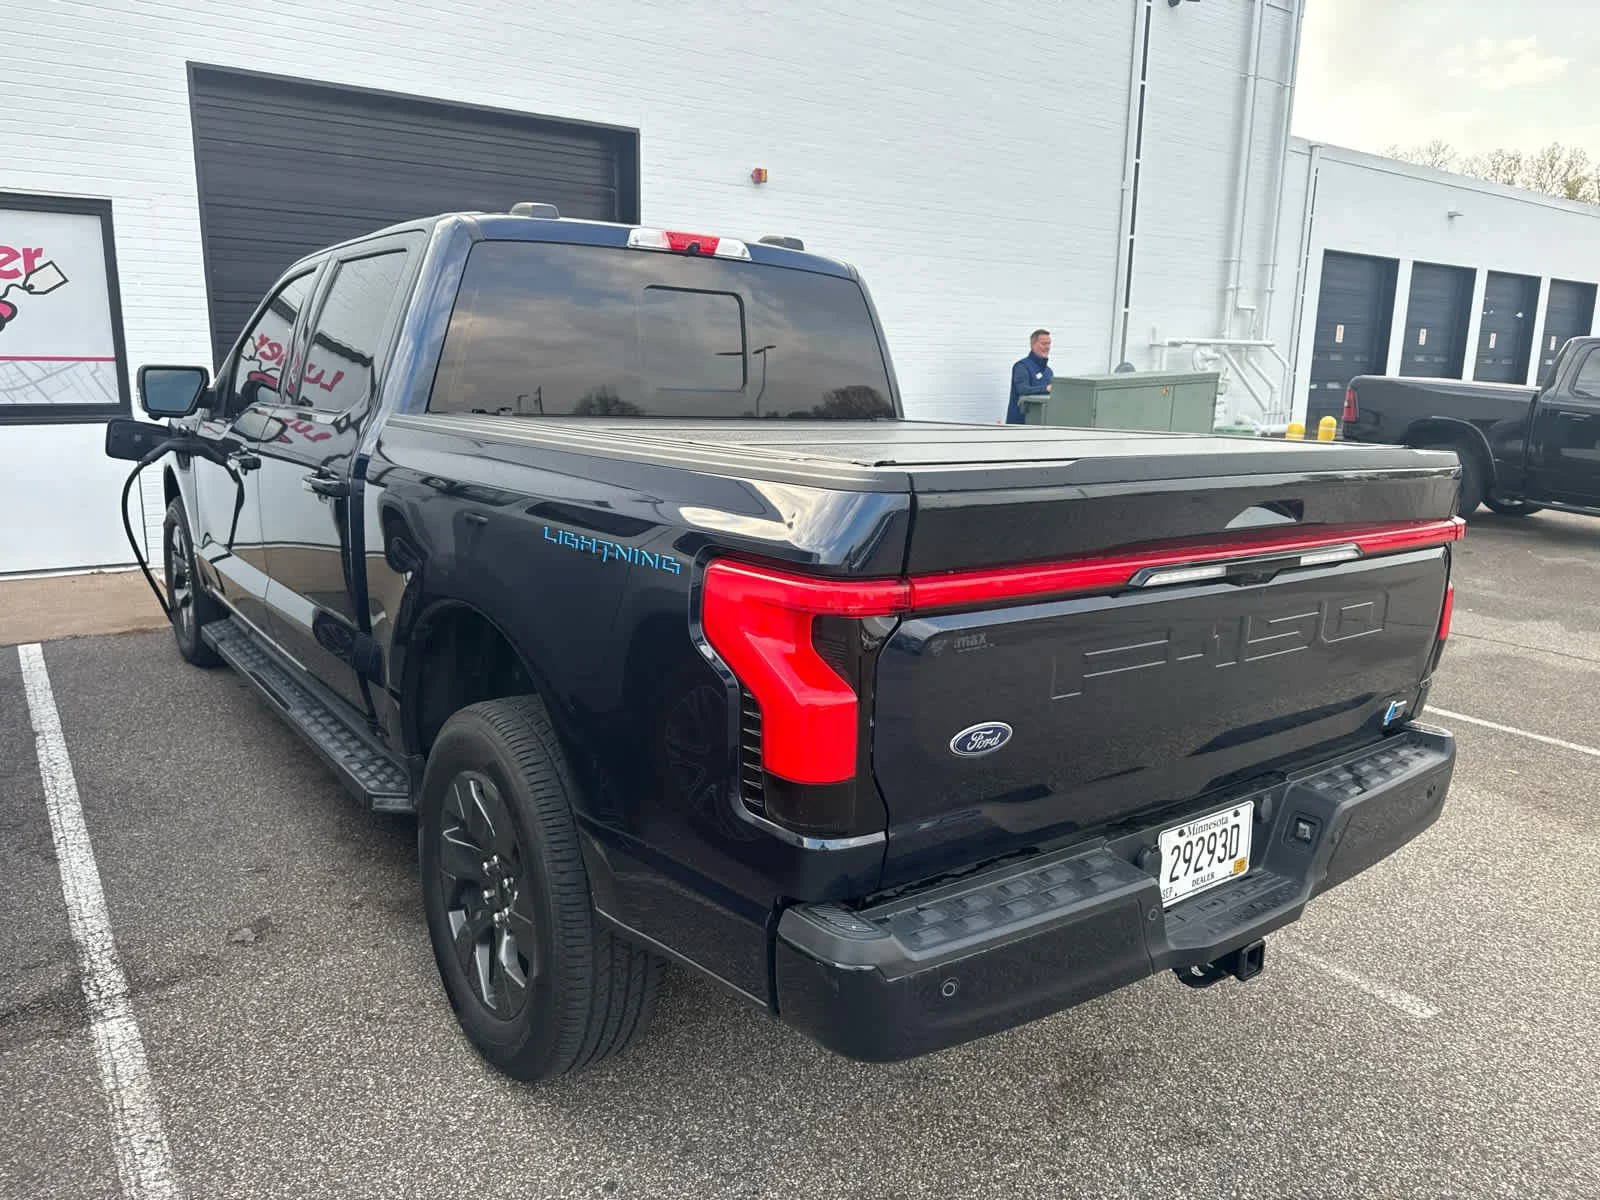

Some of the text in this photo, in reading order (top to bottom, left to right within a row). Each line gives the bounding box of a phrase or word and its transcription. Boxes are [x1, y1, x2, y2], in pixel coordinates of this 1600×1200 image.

[543, 526, 681, 575] LIGHTNING
[966, 728, 1001, 751] Ford
[1186, 816, 1229, 838] Minnesota
[1168, 823, 1240, 883] 29293D
[1191, 871, 1215, 887] DEALER
